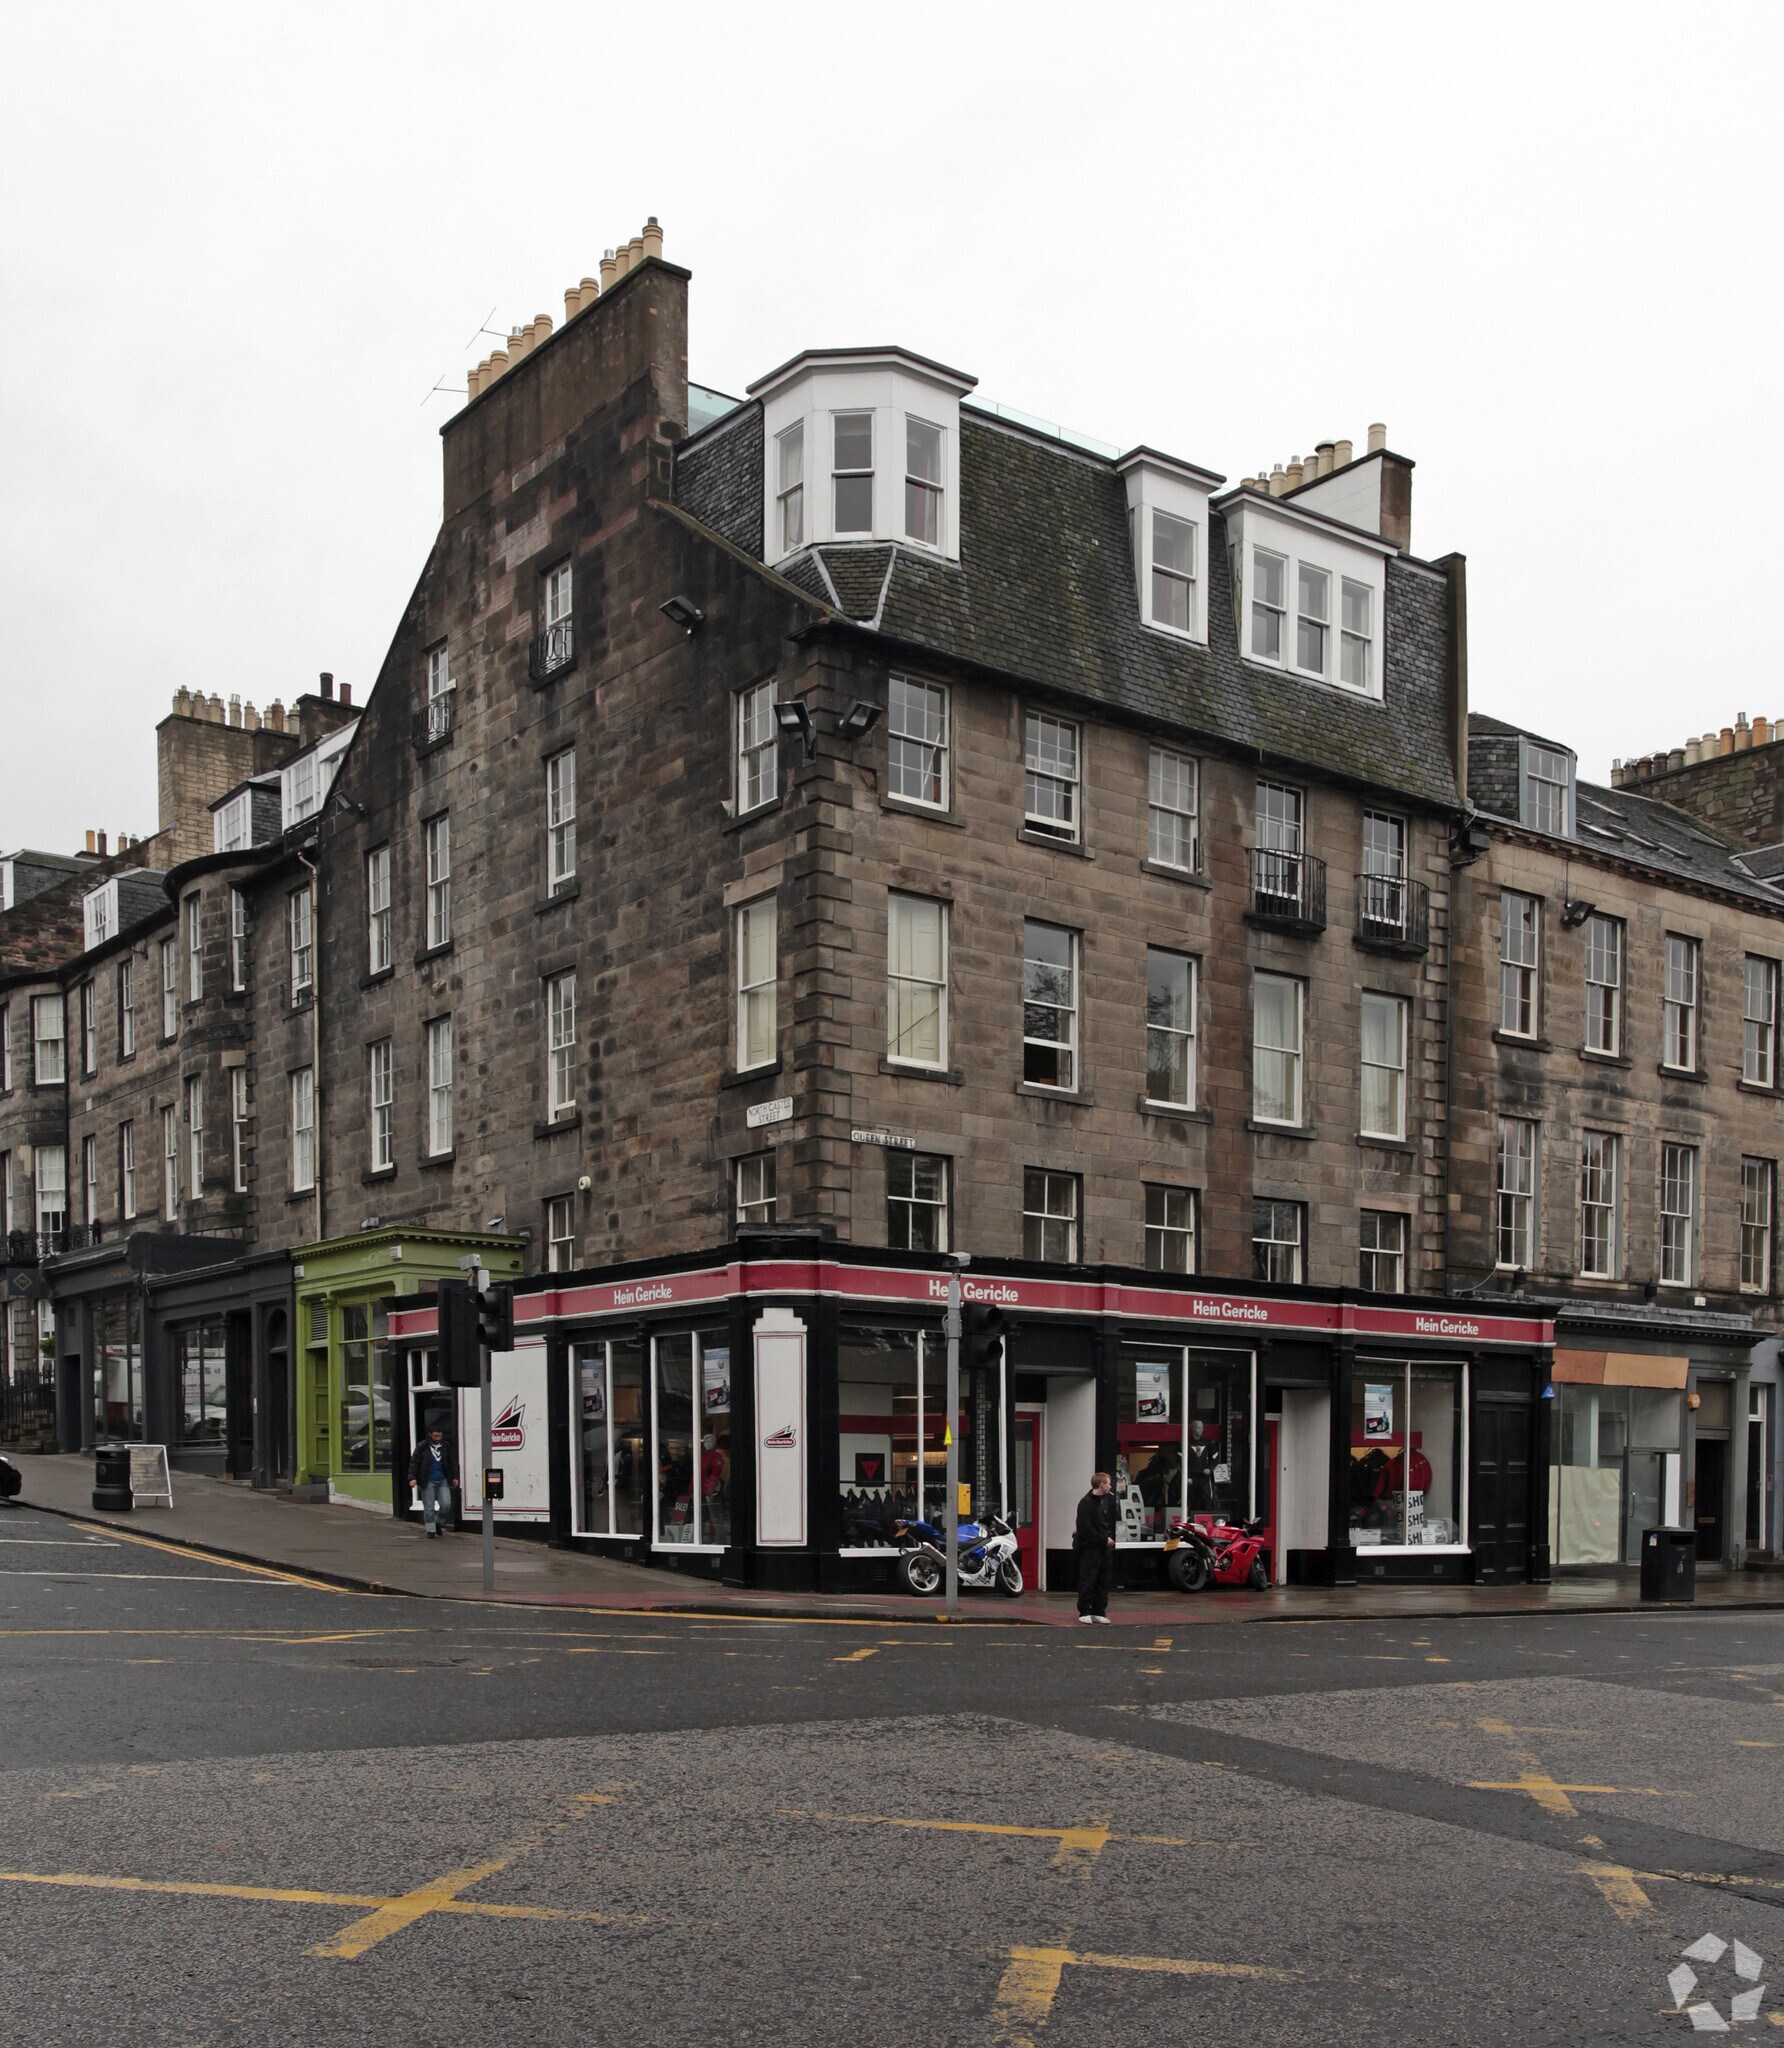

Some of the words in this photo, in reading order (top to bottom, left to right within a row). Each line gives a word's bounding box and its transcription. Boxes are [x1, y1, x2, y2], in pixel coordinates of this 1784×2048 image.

[748, 1104, 768, 1117] NORTH
[768, 1098, 791, 1111] CASTLE
[759, 1110, 781, 1124] STREET
[853, 1131, 881, 1144] QUEEN
[884, 1135, 914, 1148] STREET
[613, 1288, 634, 1305] Hein
[635, 1283, 673, 1303] Gericke
[928, 1279, 961, 1298] He
[963, 1281, 1019, 1302] Gericke
[1193, 1299, 1220, 1316] Hein
[1221, 1301, 1268, 1321] Gericke
[1415, 1316, 1439, 1333] Hein
[1440, 1318, 1479, 1335] Gericke
